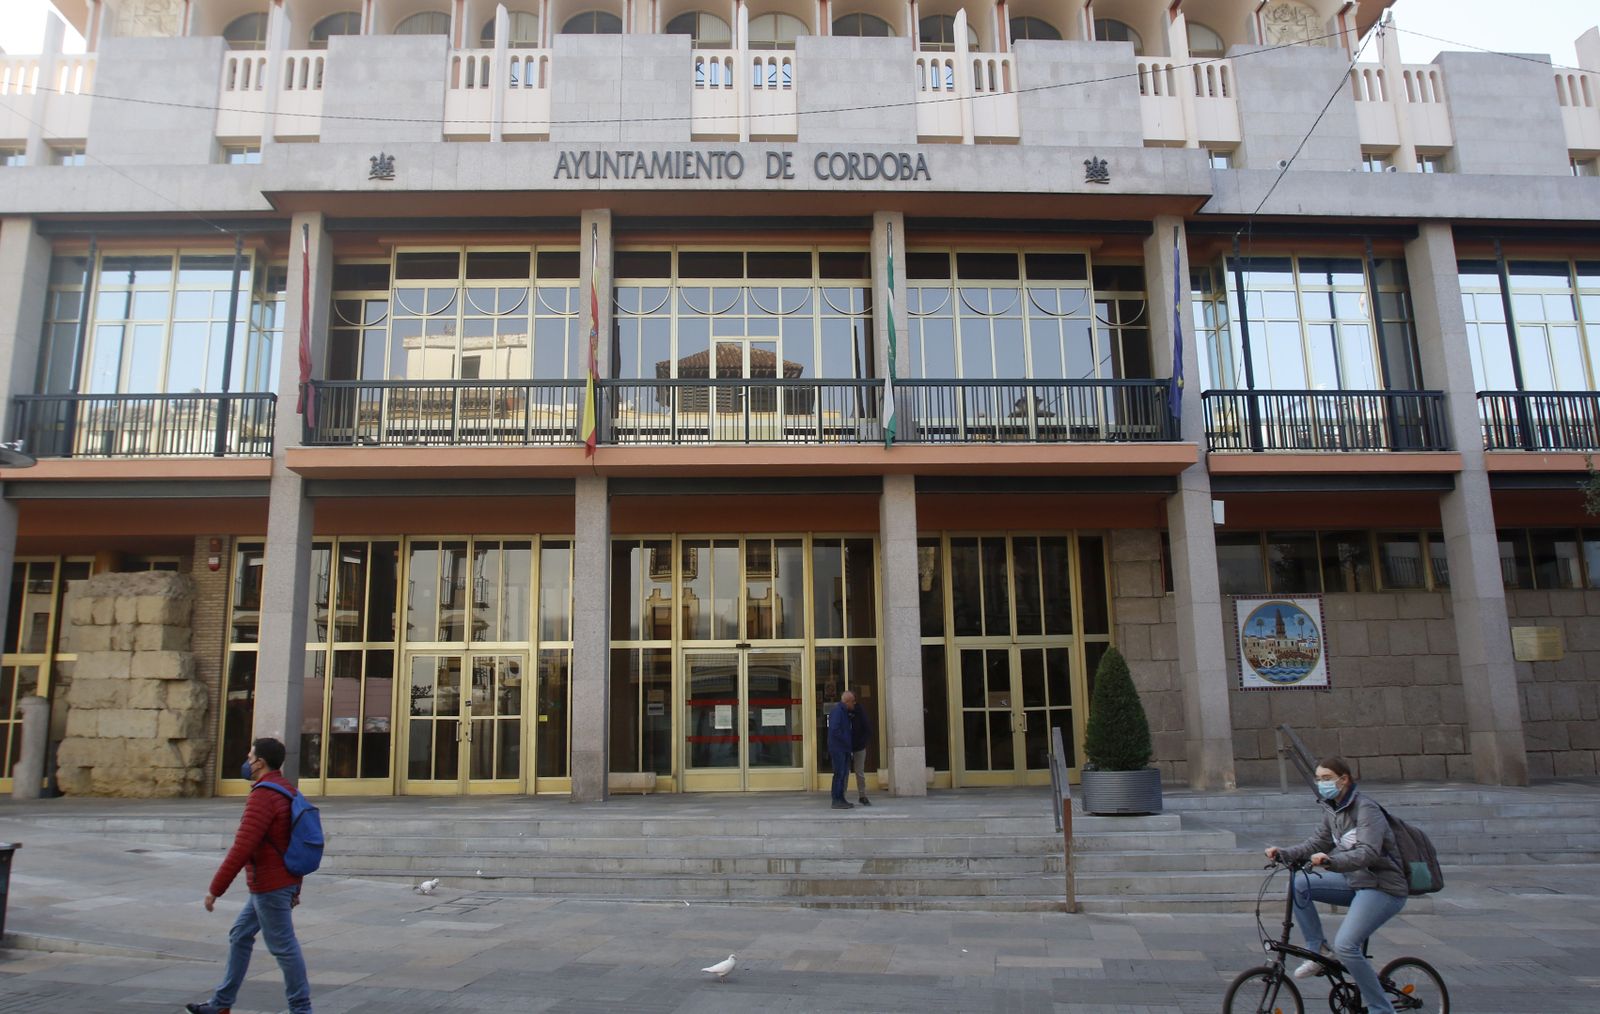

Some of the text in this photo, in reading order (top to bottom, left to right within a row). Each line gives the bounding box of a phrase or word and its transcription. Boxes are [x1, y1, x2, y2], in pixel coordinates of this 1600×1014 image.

[553, 151, 931, 181] AYUNTAMIENTO DE CORDOBA
